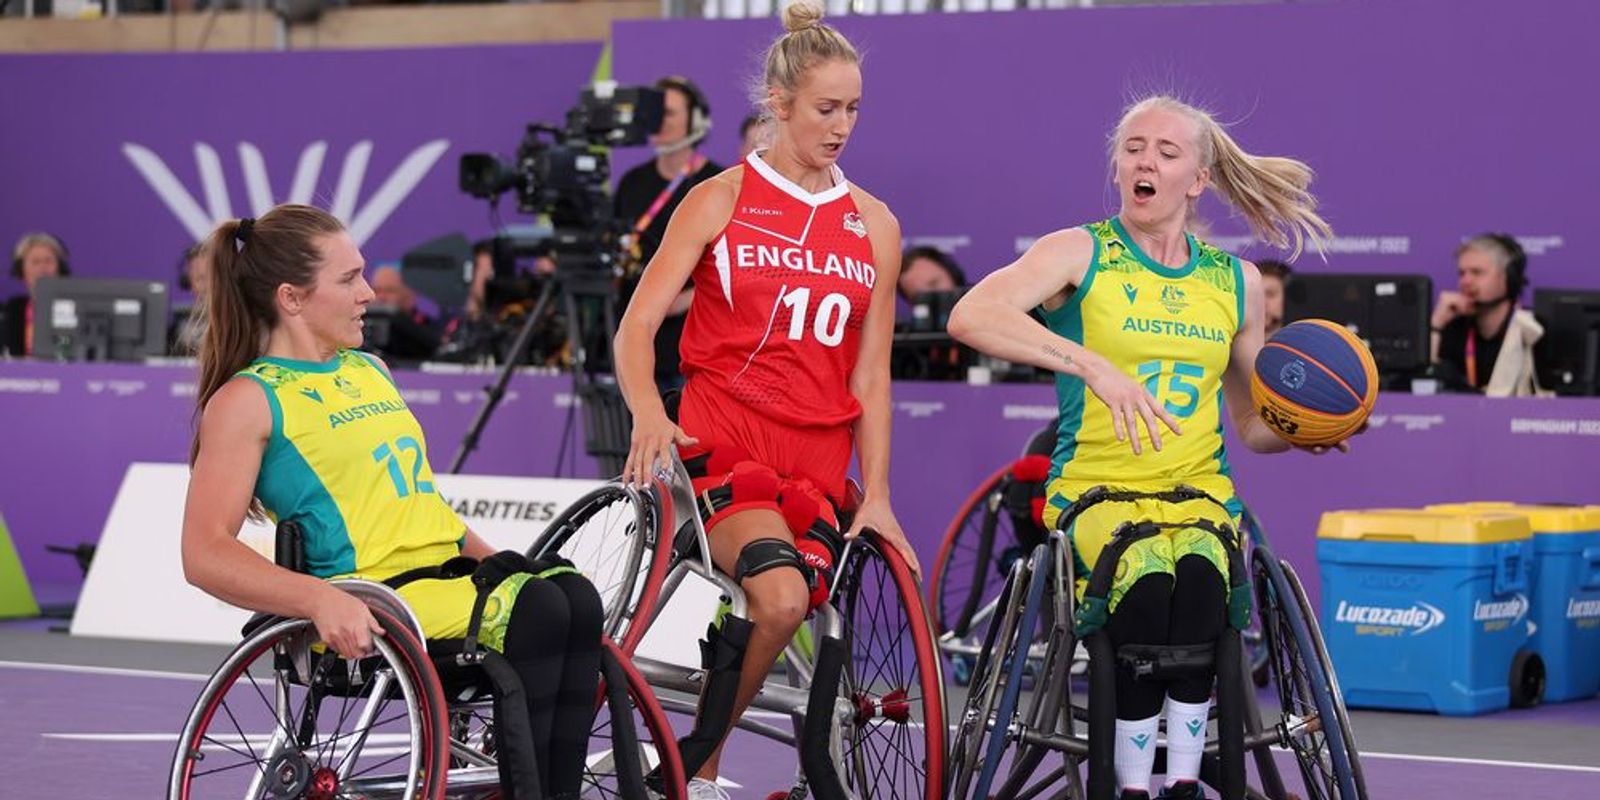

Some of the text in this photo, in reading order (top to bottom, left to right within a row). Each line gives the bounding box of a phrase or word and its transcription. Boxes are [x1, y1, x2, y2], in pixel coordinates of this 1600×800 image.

[737, 244, 876, 289] ENGLAND
[782, 287, 851, 347] 10
[1122, 317, 1226, 344] AUSTRALIA
[1137, 361, 1204, 418] 15
[372, 436, 435, 498] 12
[447, 498, 557, 521] ARITIES
[1335, 600, 1429, 628] Lucozade
